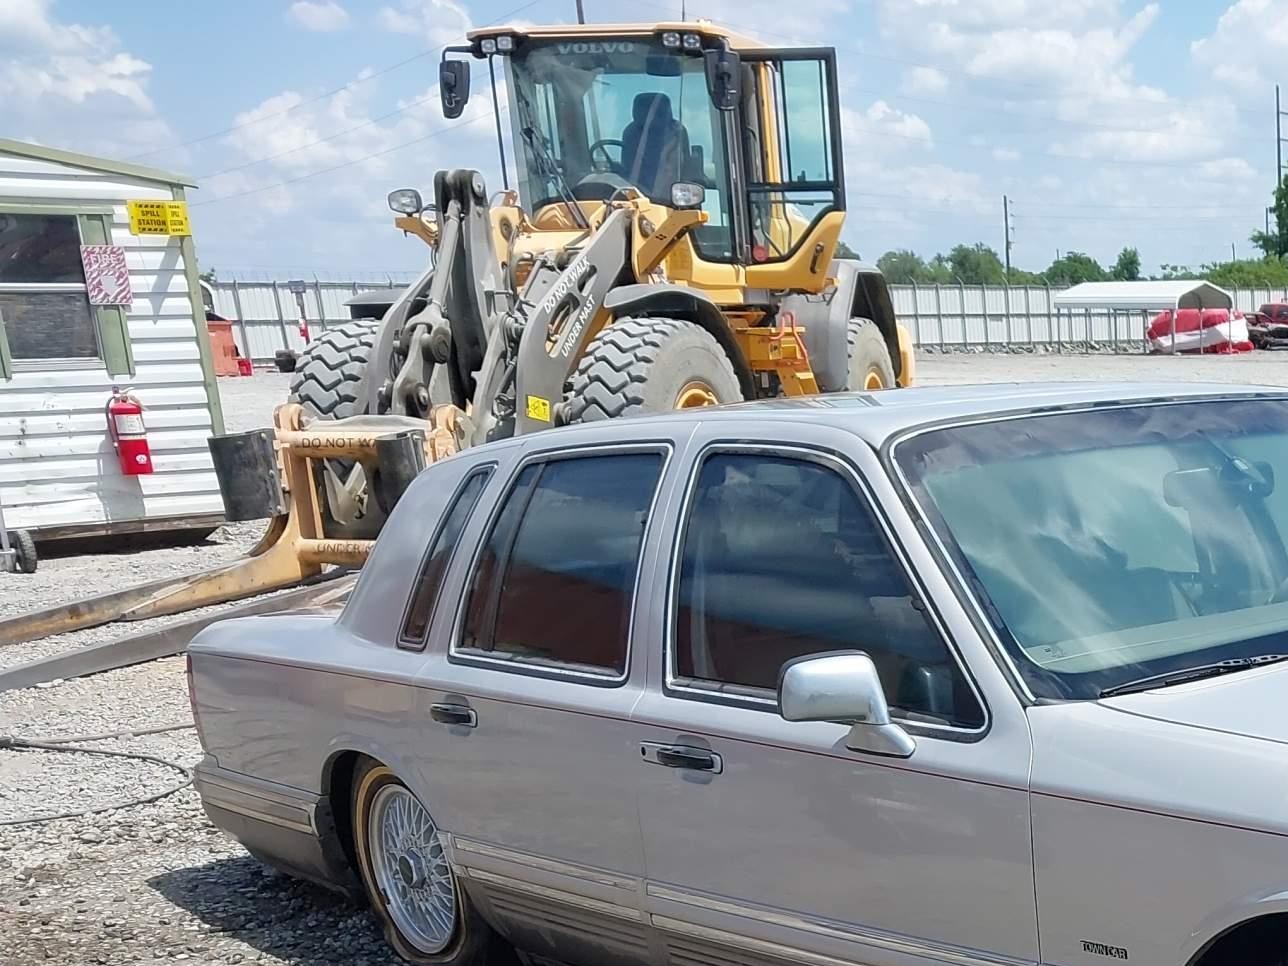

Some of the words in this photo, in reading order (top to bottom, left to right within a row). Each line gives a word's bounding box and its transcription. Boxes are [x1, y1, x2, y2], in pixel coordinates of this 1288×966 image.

[558, 42, 634, 55] VOLVO
[137, 218, 167, 226] STATION
[89, 253, 120, 265] FIRE
[544, 295, 556, 314] DO
[553, 277, 574, 301] NOT
[568, 256, 590, 282] WALK
[561, 321, 583, 358] UNDER
[579, 294, 596, 325] MAST
[301, 438, 321, 449] DO
[325, 438, 355, 449] NOT
[317, 543, 362, 553] UNDER
